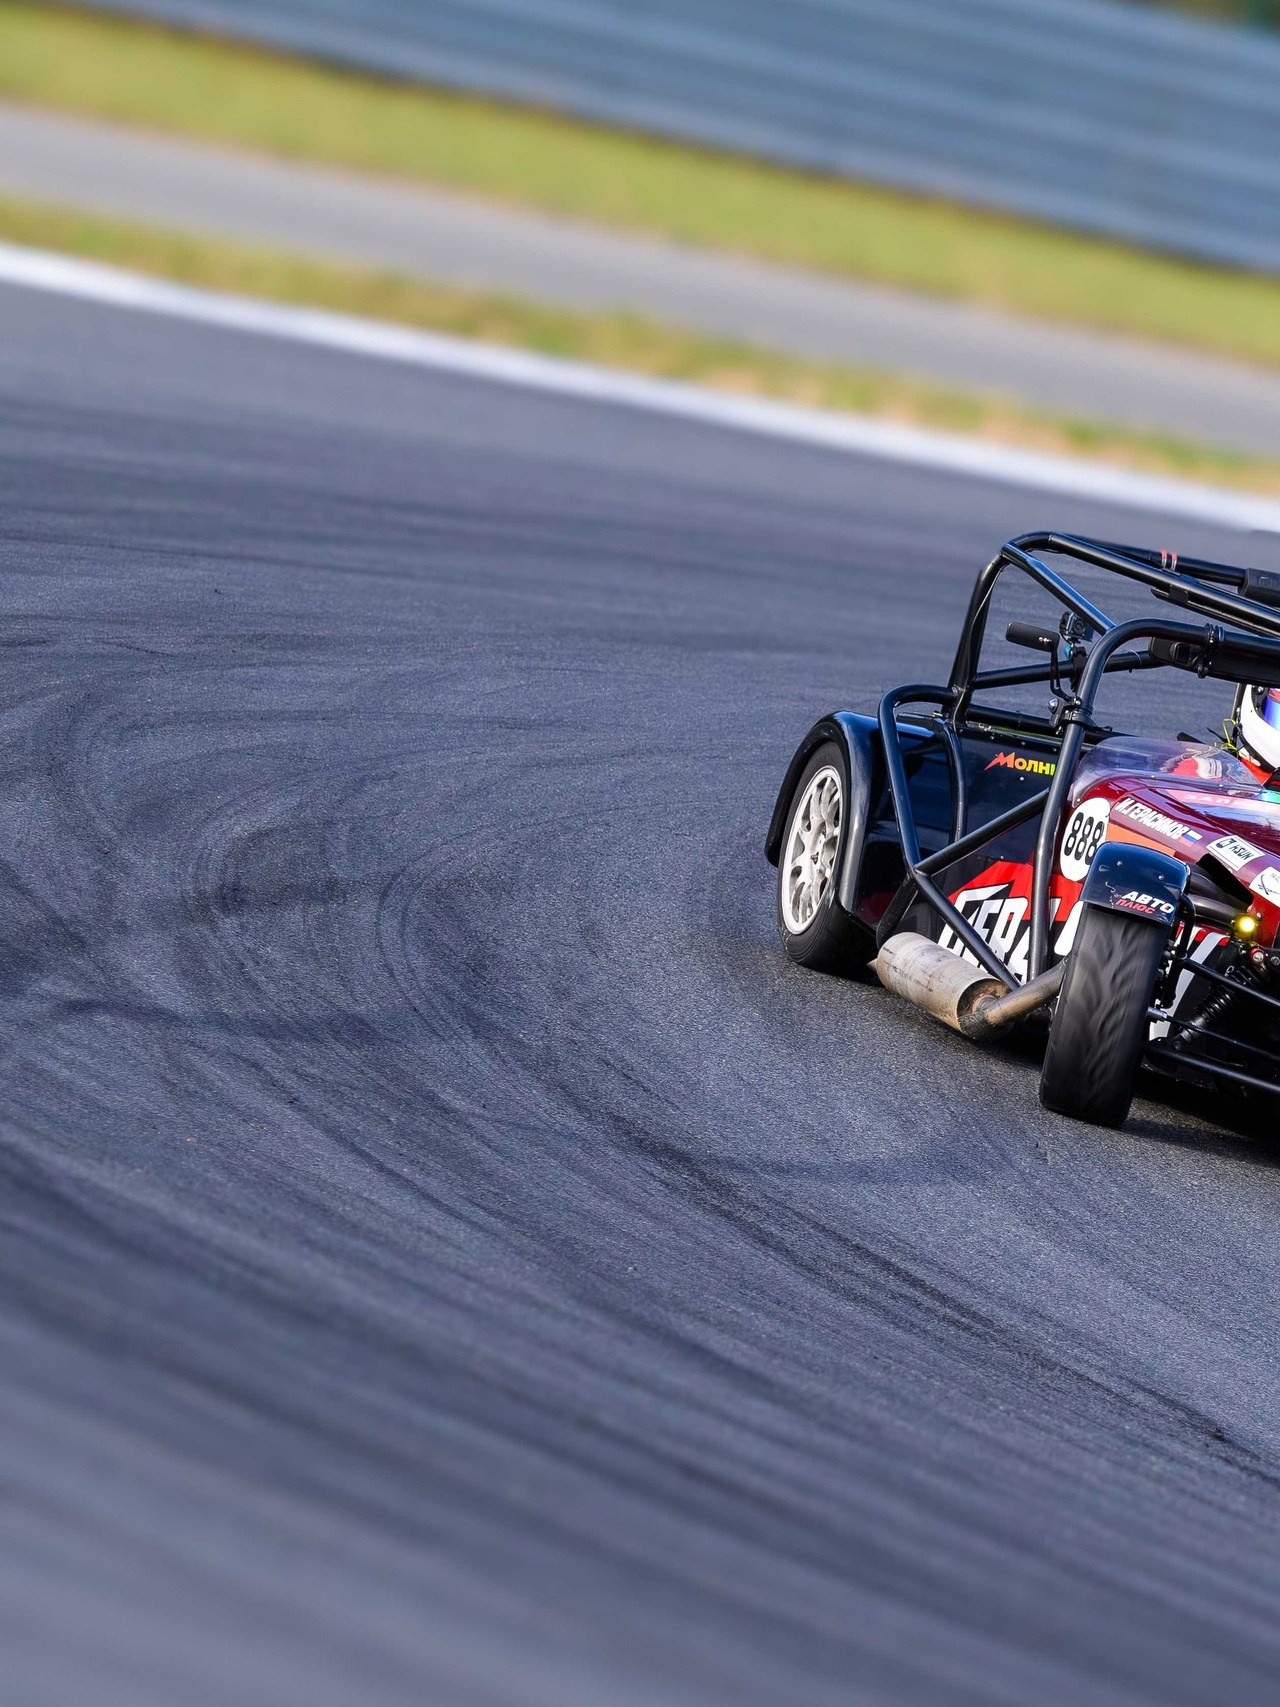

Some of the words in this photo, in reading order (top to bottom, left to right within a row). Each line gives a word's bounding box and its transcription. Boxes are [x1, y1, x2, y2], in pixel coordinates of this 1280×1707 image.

[1064, 811, 1105, 866] 888
[1115, 898, 1156, 915] ПЛЮС
[1121, 890, 1175, 914] АВТО
